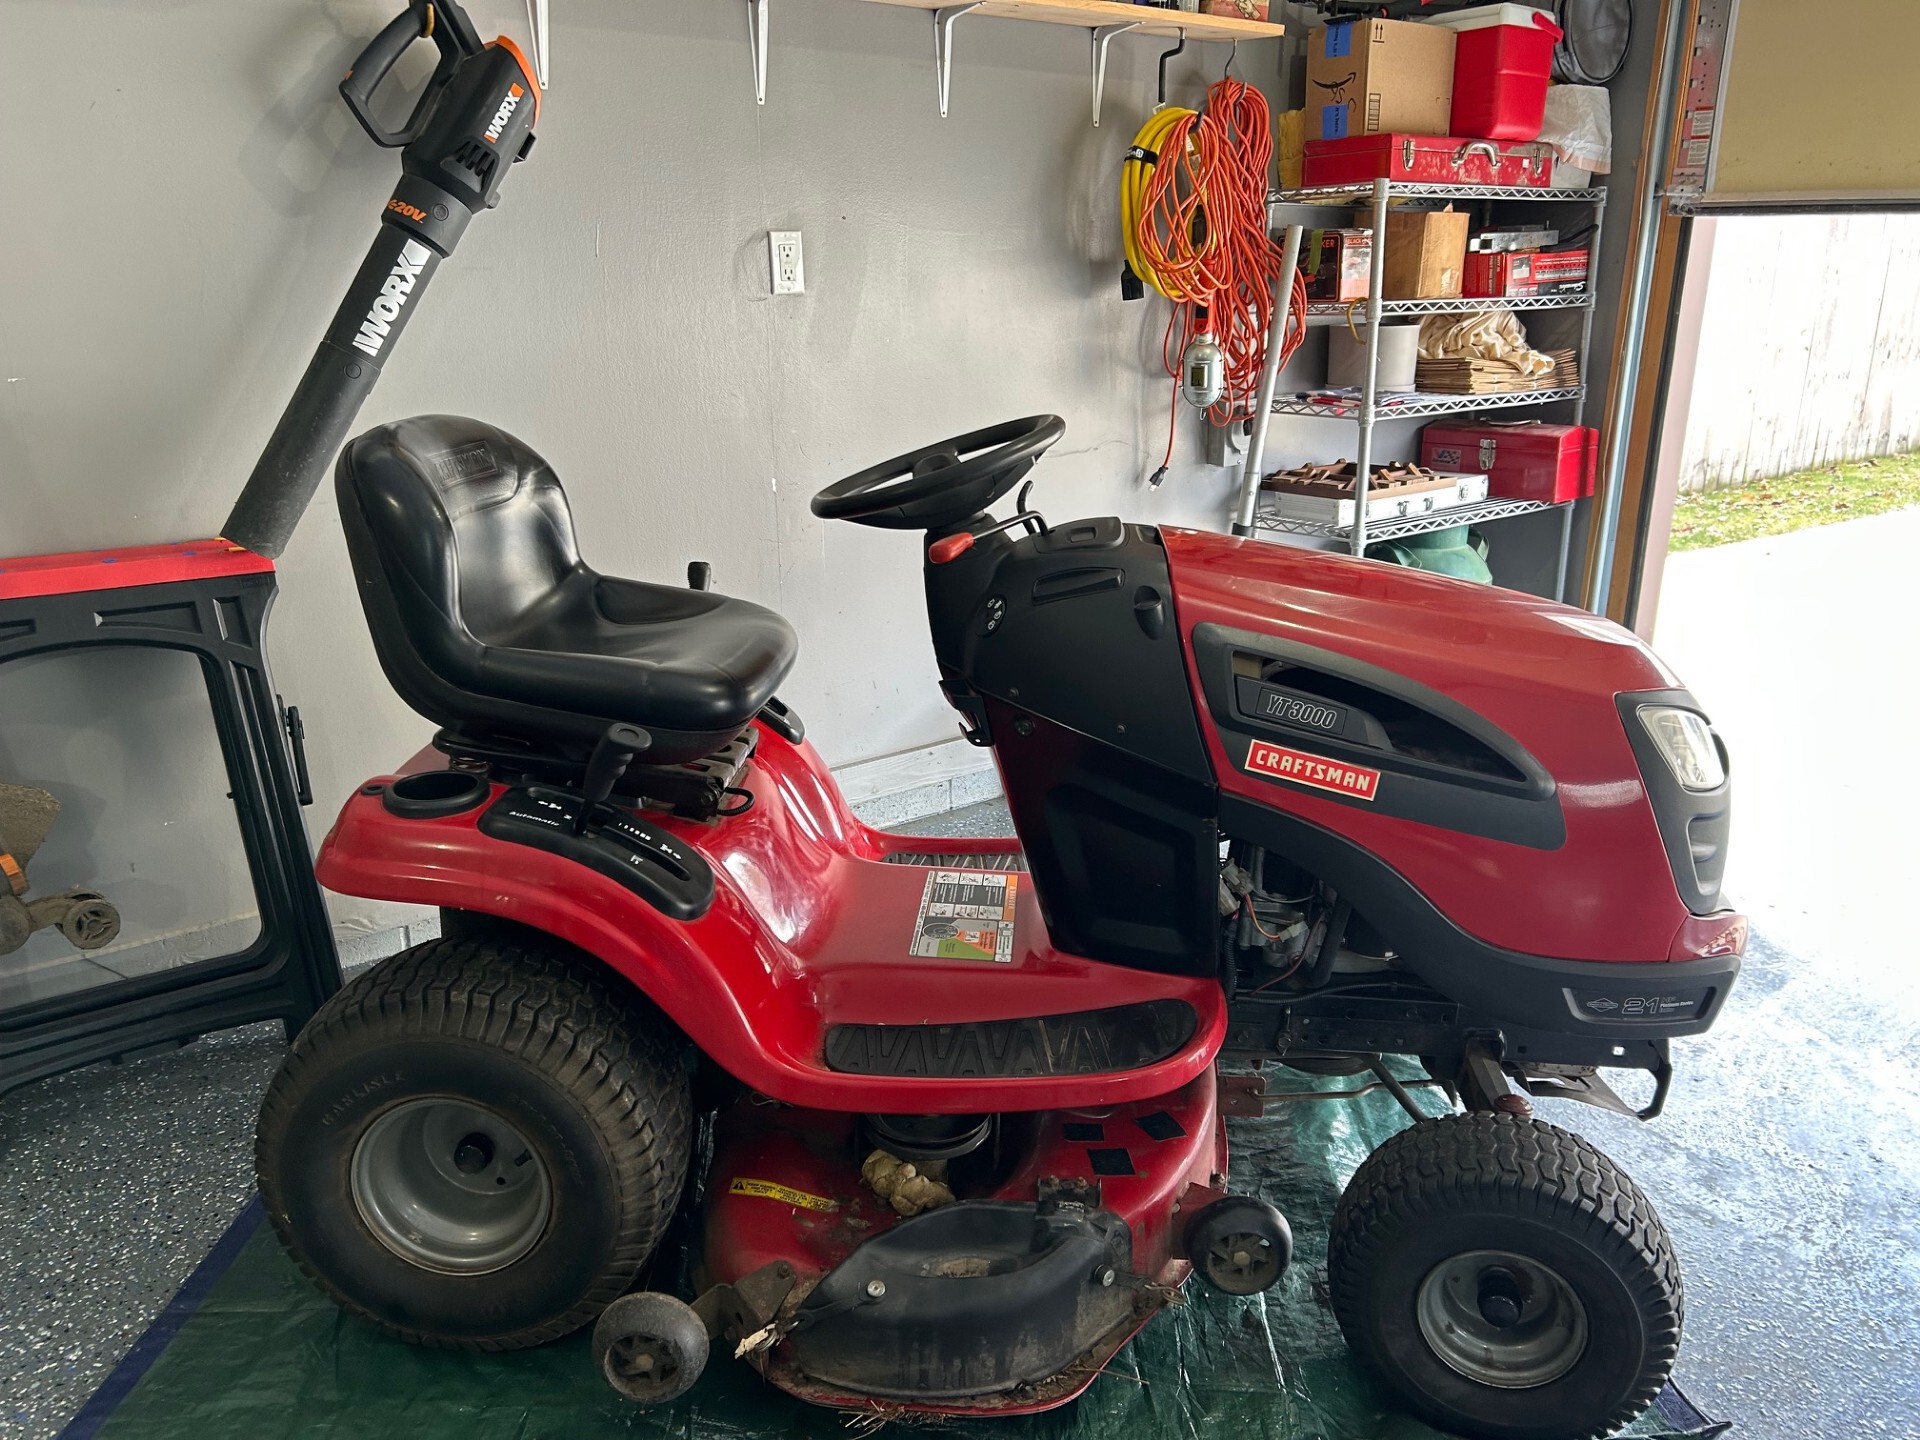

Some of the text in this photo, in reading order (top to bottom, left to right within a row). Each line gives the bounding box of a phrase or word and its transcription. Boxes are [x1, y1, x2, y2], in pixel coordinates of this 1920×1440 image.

[485, 90, 520, 139] WORX
[394, 201, 426, 222] 20V
[353, 250, 426, 353] WORX
[1256, 749, 1371, 791] CRAFTSMAN
[509, 811, 560, 826] Automatic
[1622, 997, 1659, 1014] 21
